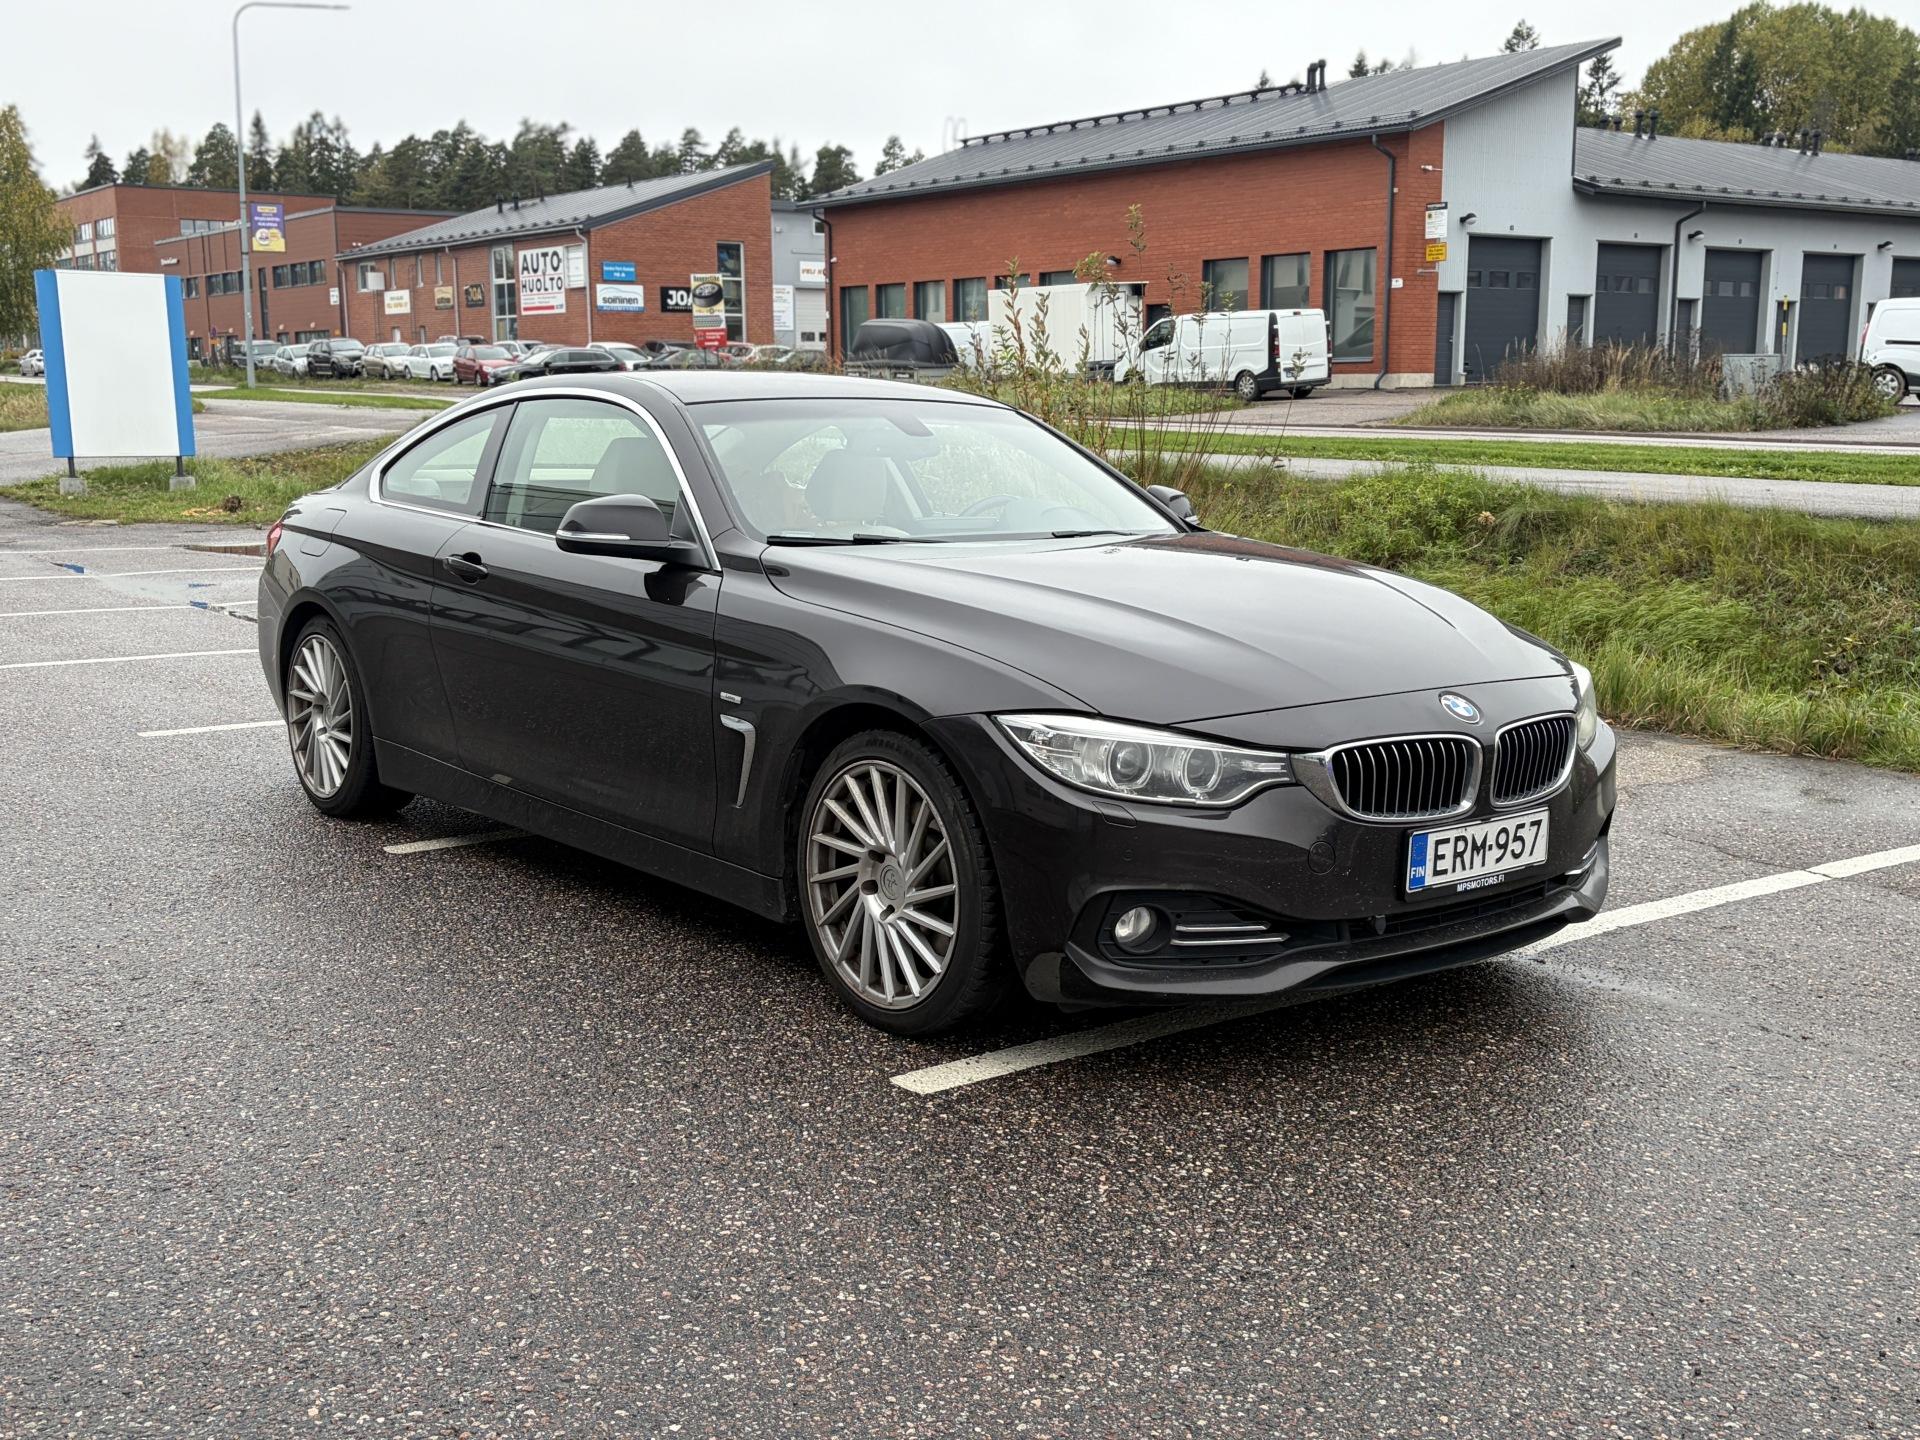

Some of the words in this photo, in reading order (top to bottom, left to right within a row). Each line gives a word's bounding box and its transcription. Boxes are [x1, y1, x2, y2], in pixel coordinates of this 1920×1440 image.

[521, 276, 563, 293] HUOLTO
[1432, 819, 1543, 877] ERM-957
[1410, 864, 1426, 879] FIN
[1457, 874, 1505, 892] MPSMOTORS.FI
